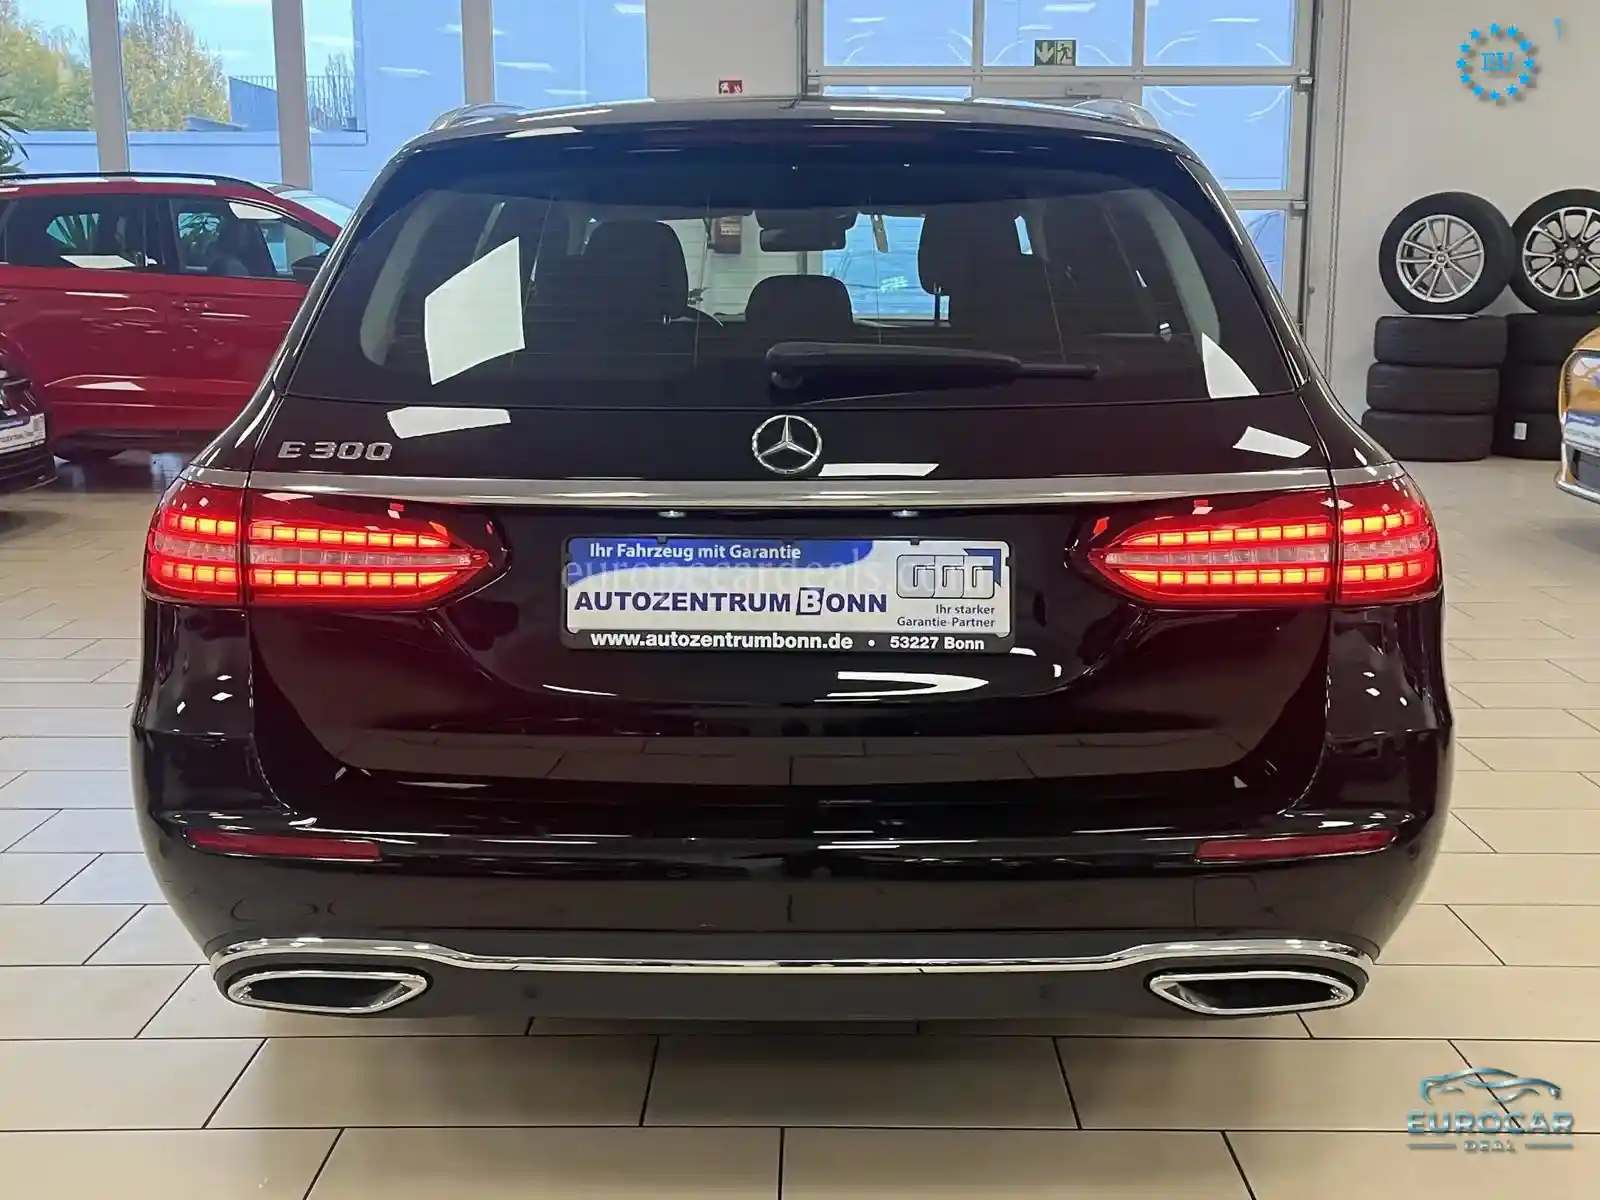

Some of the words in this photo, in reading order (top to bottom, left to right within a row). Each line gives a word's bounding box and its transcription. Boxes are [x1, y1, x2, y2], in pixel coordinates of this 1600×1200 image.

[277, 441, 306, 459] E
[309, 441, 393, 461] 300
[590, 543, 613, 558] Ihr
[617, 543, 694, 561] Fahrzeug
[698, 545, 726, 560] mit
[730, 545, 801, 560] Garantie
[574, 591, 791, 612] AUTOZENTRUM
[796, 587, 887, 615] BONN
[935, 604, 950, 614] Ihr
[955, 604, 995, 615] starker
[896, 616, 996, 628] Garantie-Partner
[590, 632, 853, 649] www.autozentrumbonn.de
[889, 636, 939, 650] 53227
[944, 637, 985, 650] Bonn
